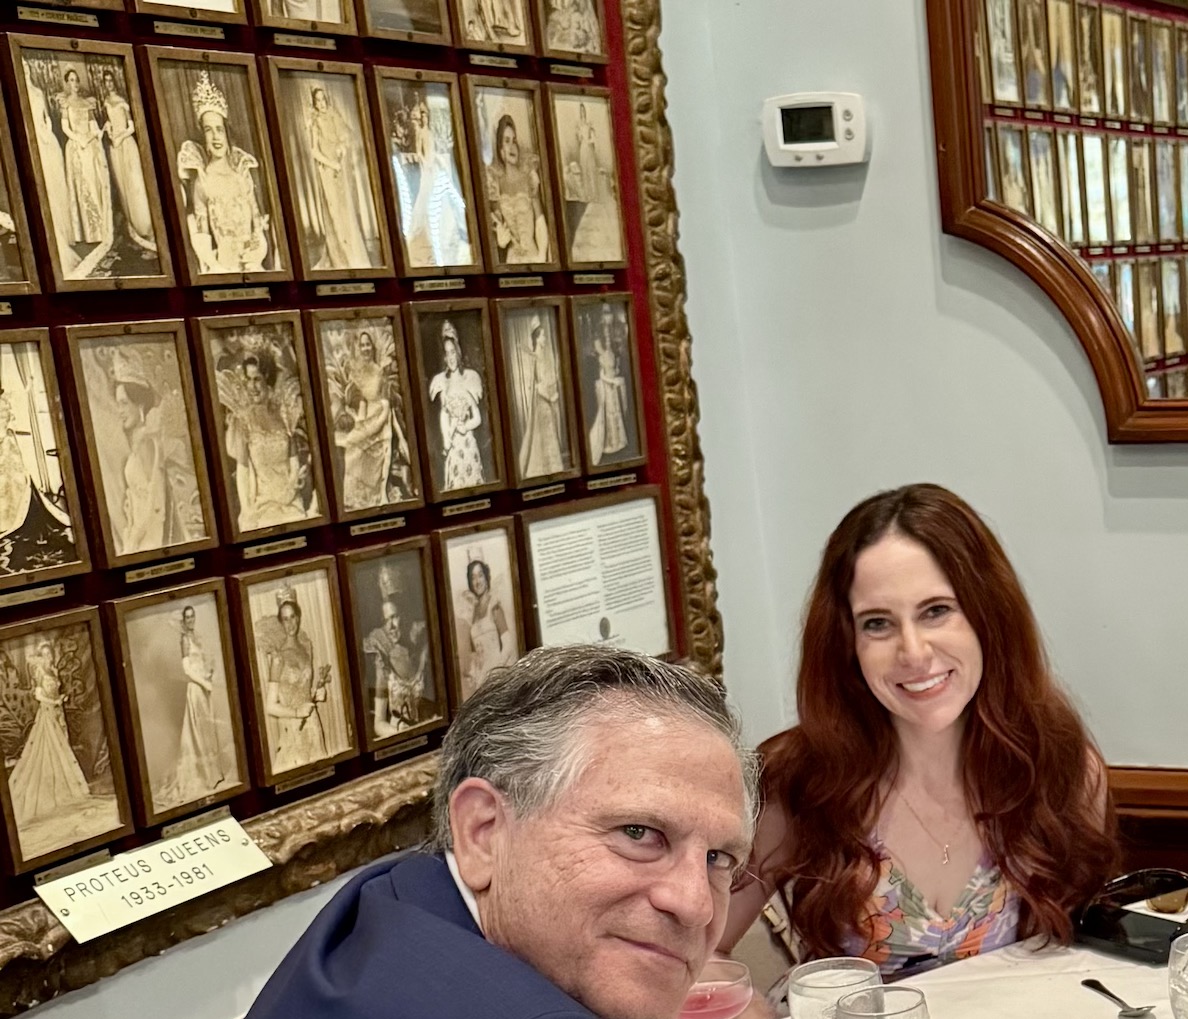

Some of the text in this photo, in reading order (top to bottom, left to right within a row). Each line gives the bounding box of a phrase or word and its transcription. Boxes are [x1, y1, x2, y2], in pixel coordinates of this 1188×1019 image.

[64, 859, 152, 902] PROTEUS
[160, 829, 231, 865] QUEENS
[121, 863, 214, 908] 1933-1981
